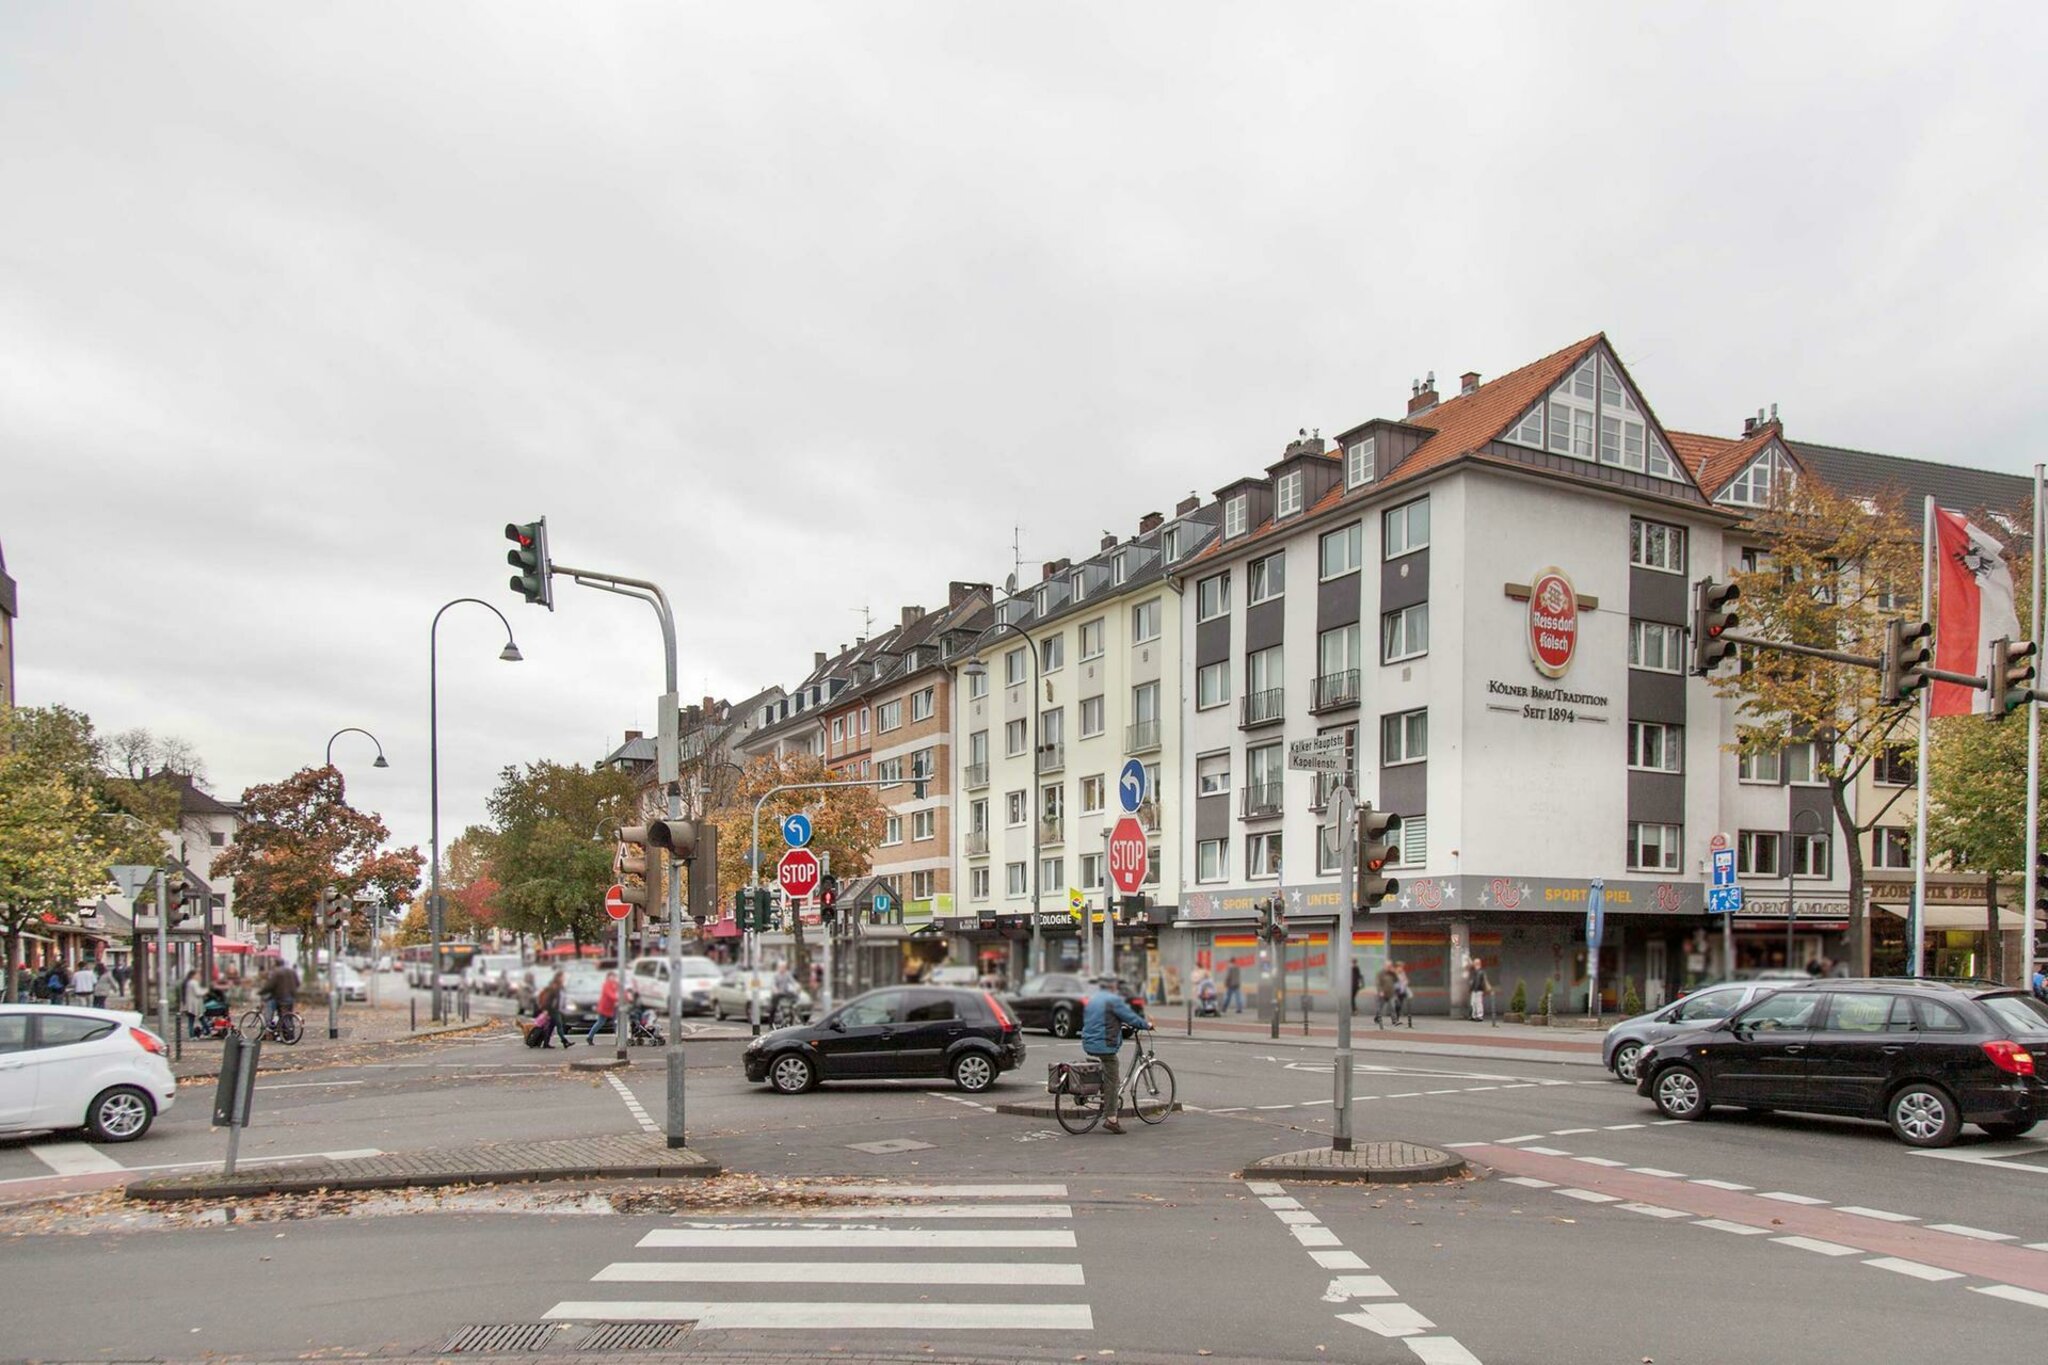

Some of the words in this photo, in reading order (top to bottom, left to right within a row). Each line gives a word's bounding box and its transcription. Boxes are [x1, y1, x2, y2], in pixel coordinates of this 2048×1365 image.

[1540, 632, 1568, 653] Kölsch
[1548, 707, 1574, 723] 1894
[1290, 740, 1312, 753] Kalker
[1313, 734, 1345, 750] Hauptstr.
[1293, 755, 1338, 769] Kapellenstr.
[1112, 840, 1143, 871] STOP
[782, 864, 816, 884] STOP
[1413, 880, 1442, 909] Rio
[1491, 877, 1521, 910] Rio
[1545, 888, 1588, 904] SPORT
[1605, 890, 1633, 904] PIEL
[1656, 883, 1681, 912] Rio
[876, 897, 888, 911] U
